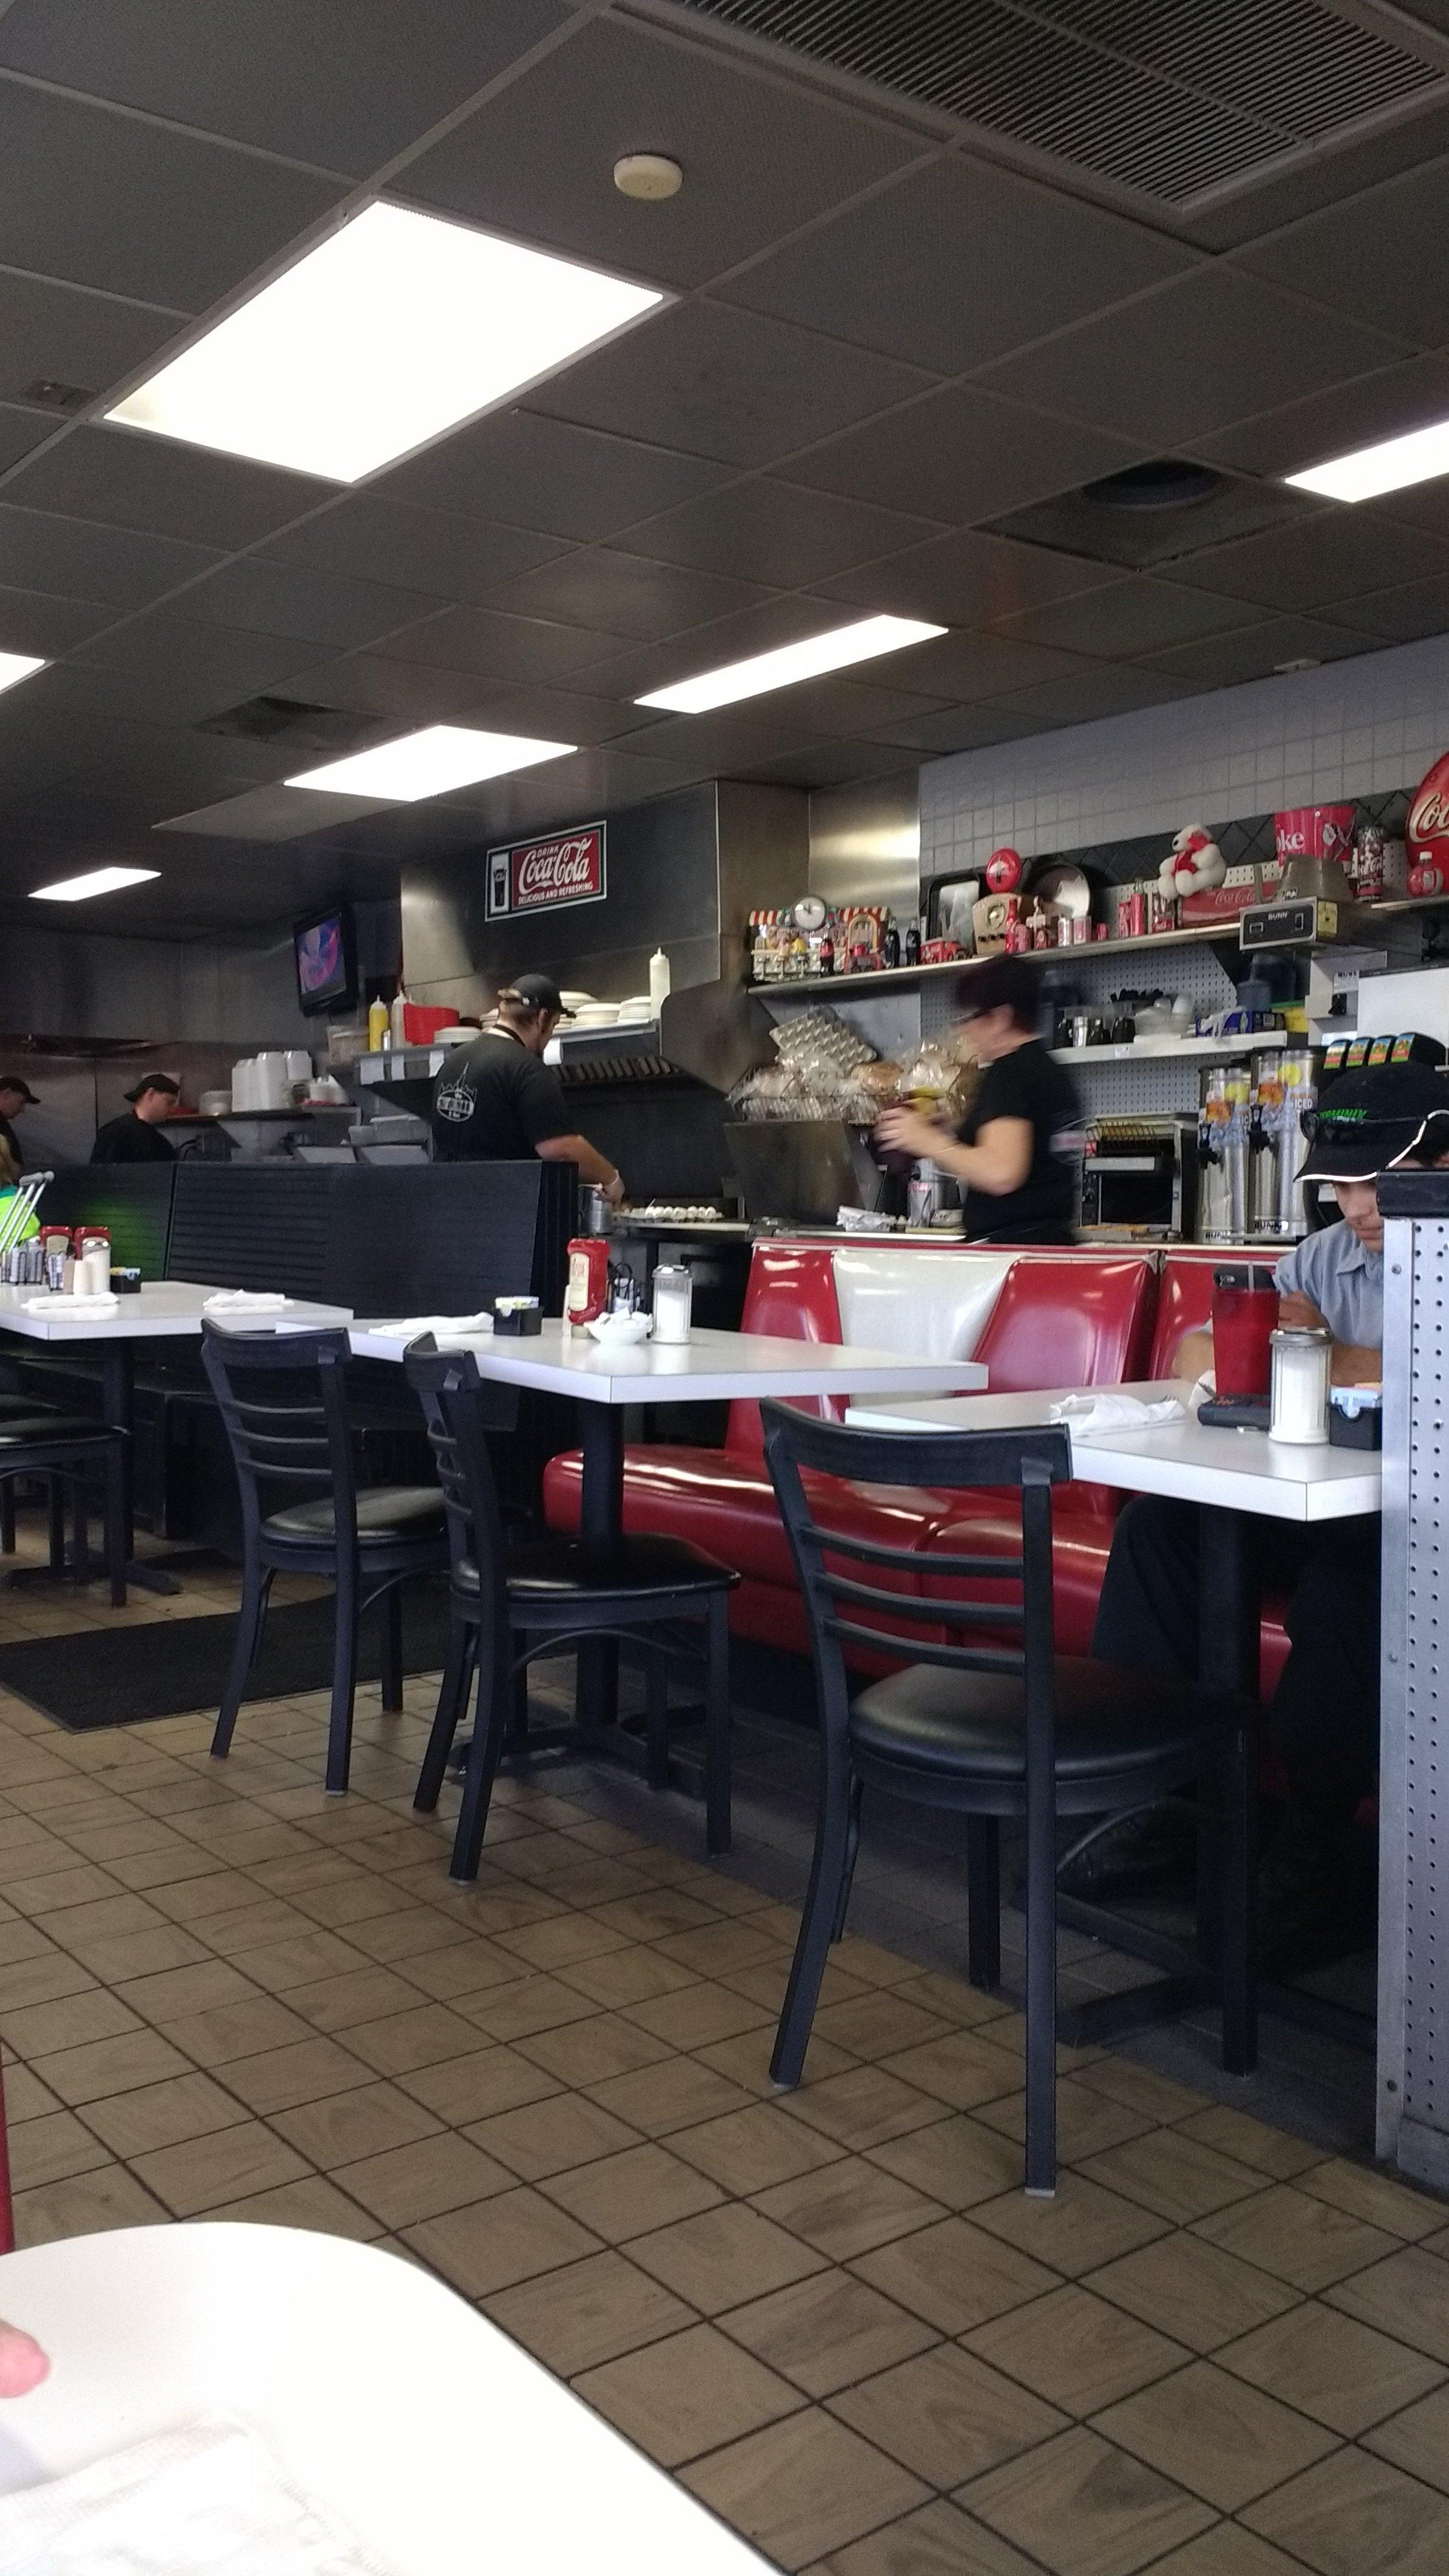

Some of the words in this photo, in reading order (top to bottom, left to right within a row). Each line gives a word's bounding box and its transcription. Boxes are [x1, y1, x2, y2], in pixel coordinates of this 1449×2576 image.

[536, 844, 559, 858] DRINK
[546, 888, 558, 899] AND
[559, 881, 593, 896] REFRESHING
[1294, 1098, 1313, 1110] ICED
